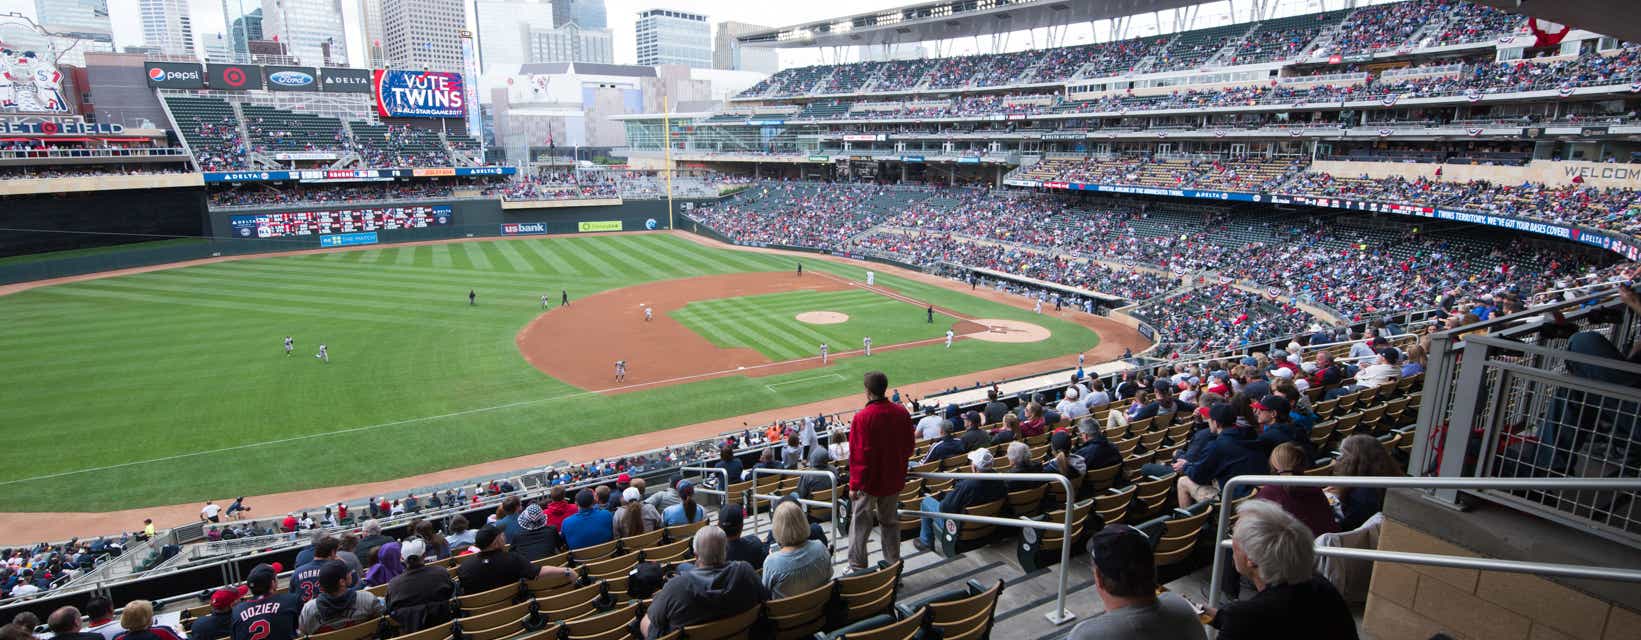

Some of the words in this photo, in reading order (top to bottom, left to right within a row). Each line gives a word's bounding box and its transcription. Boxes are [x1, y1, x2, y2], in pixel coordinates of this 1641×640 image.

[167, 70, 200, 81] pepsi
[278, 71, 304, 86] Ford
[404, 74, 449, 90] VOTE
[392, 87, 462, 107] TWINS
[63, 122, 124, 134] FIELD
[1437, 210, 1455, 219] TWINS
[1505, 218, 1515, 228] GOT
[1515, 219, 1531, 230] YOUR
[1530, 222, 1547, 233] BASES
[1585, 234, 1602, 245] DELTA
[240, 602, 280, 622] DOZIER
[248, 619, 271, 640] 2
